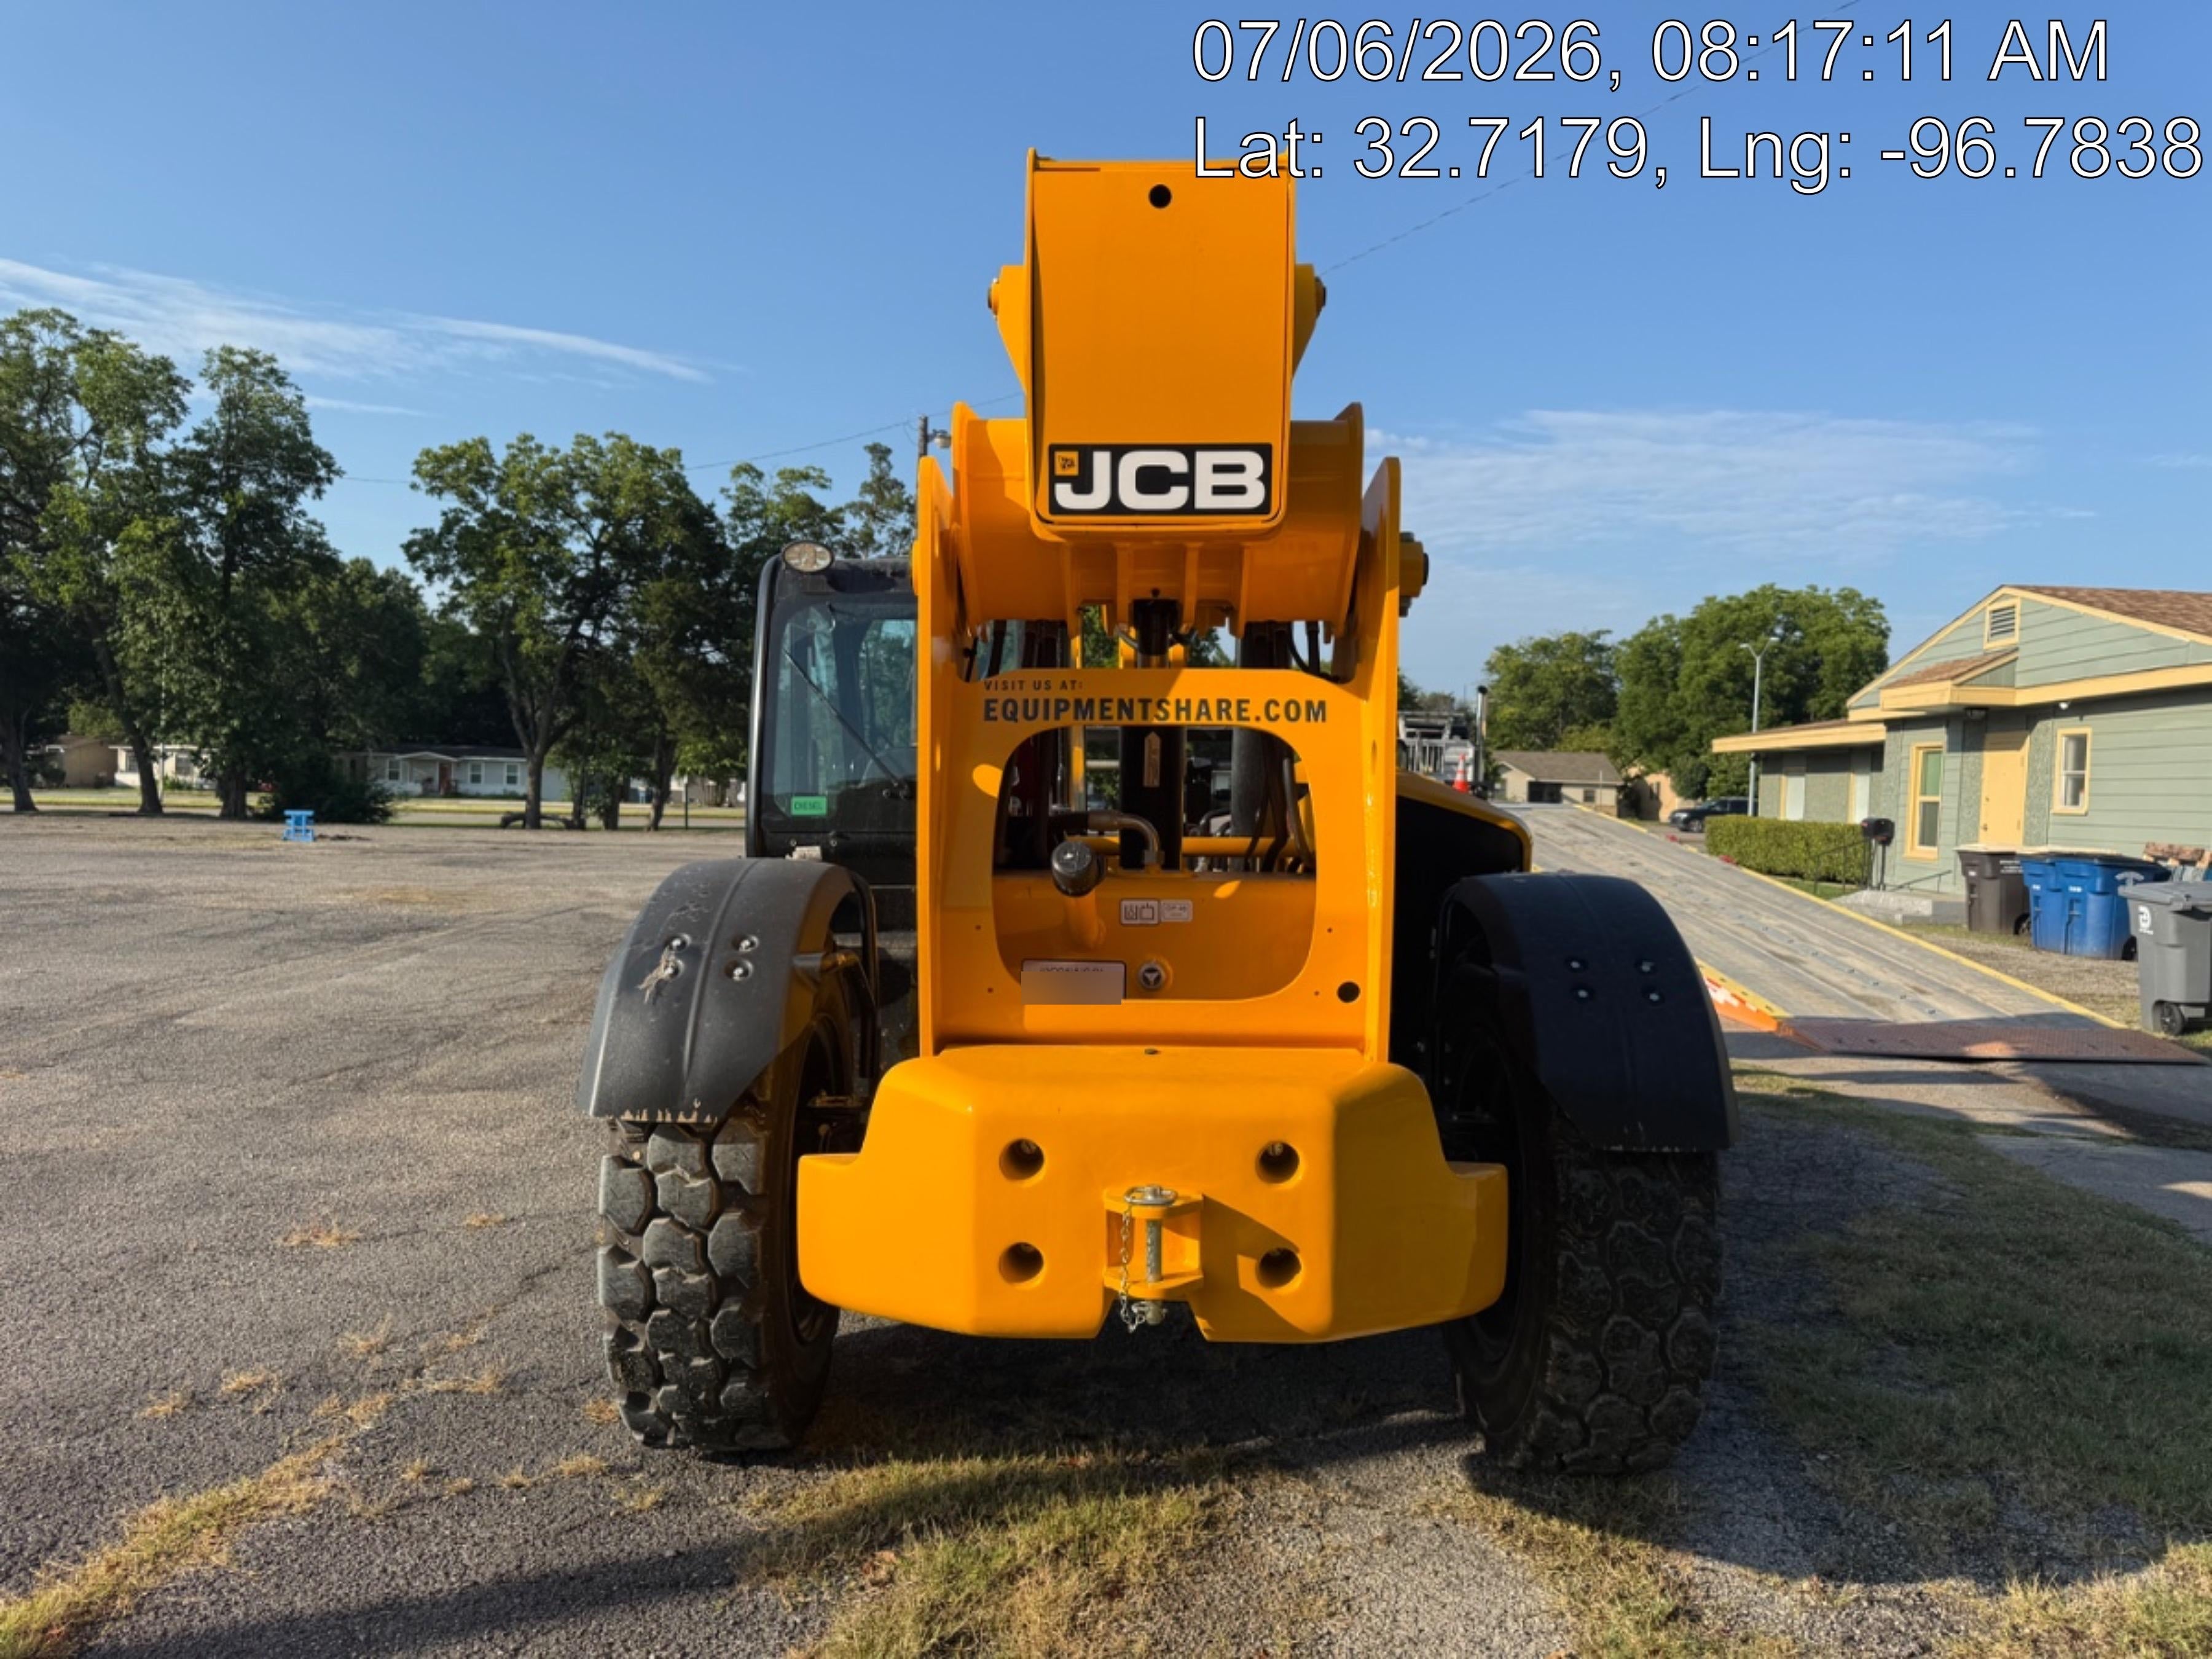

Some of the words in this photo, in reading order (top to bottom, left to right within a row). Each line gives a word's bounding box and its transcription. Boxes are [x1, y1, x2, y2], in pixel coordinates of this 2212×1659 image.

[1054, 450, 1266, 510] JCB
[984, 680, 1025, 691] VISIT
[1033, 680, 1052, 691] US
[1059, 680, 1083, 691] AT:
[984, 698, 1327, 723] EQUIPMENTSHARE.COM
